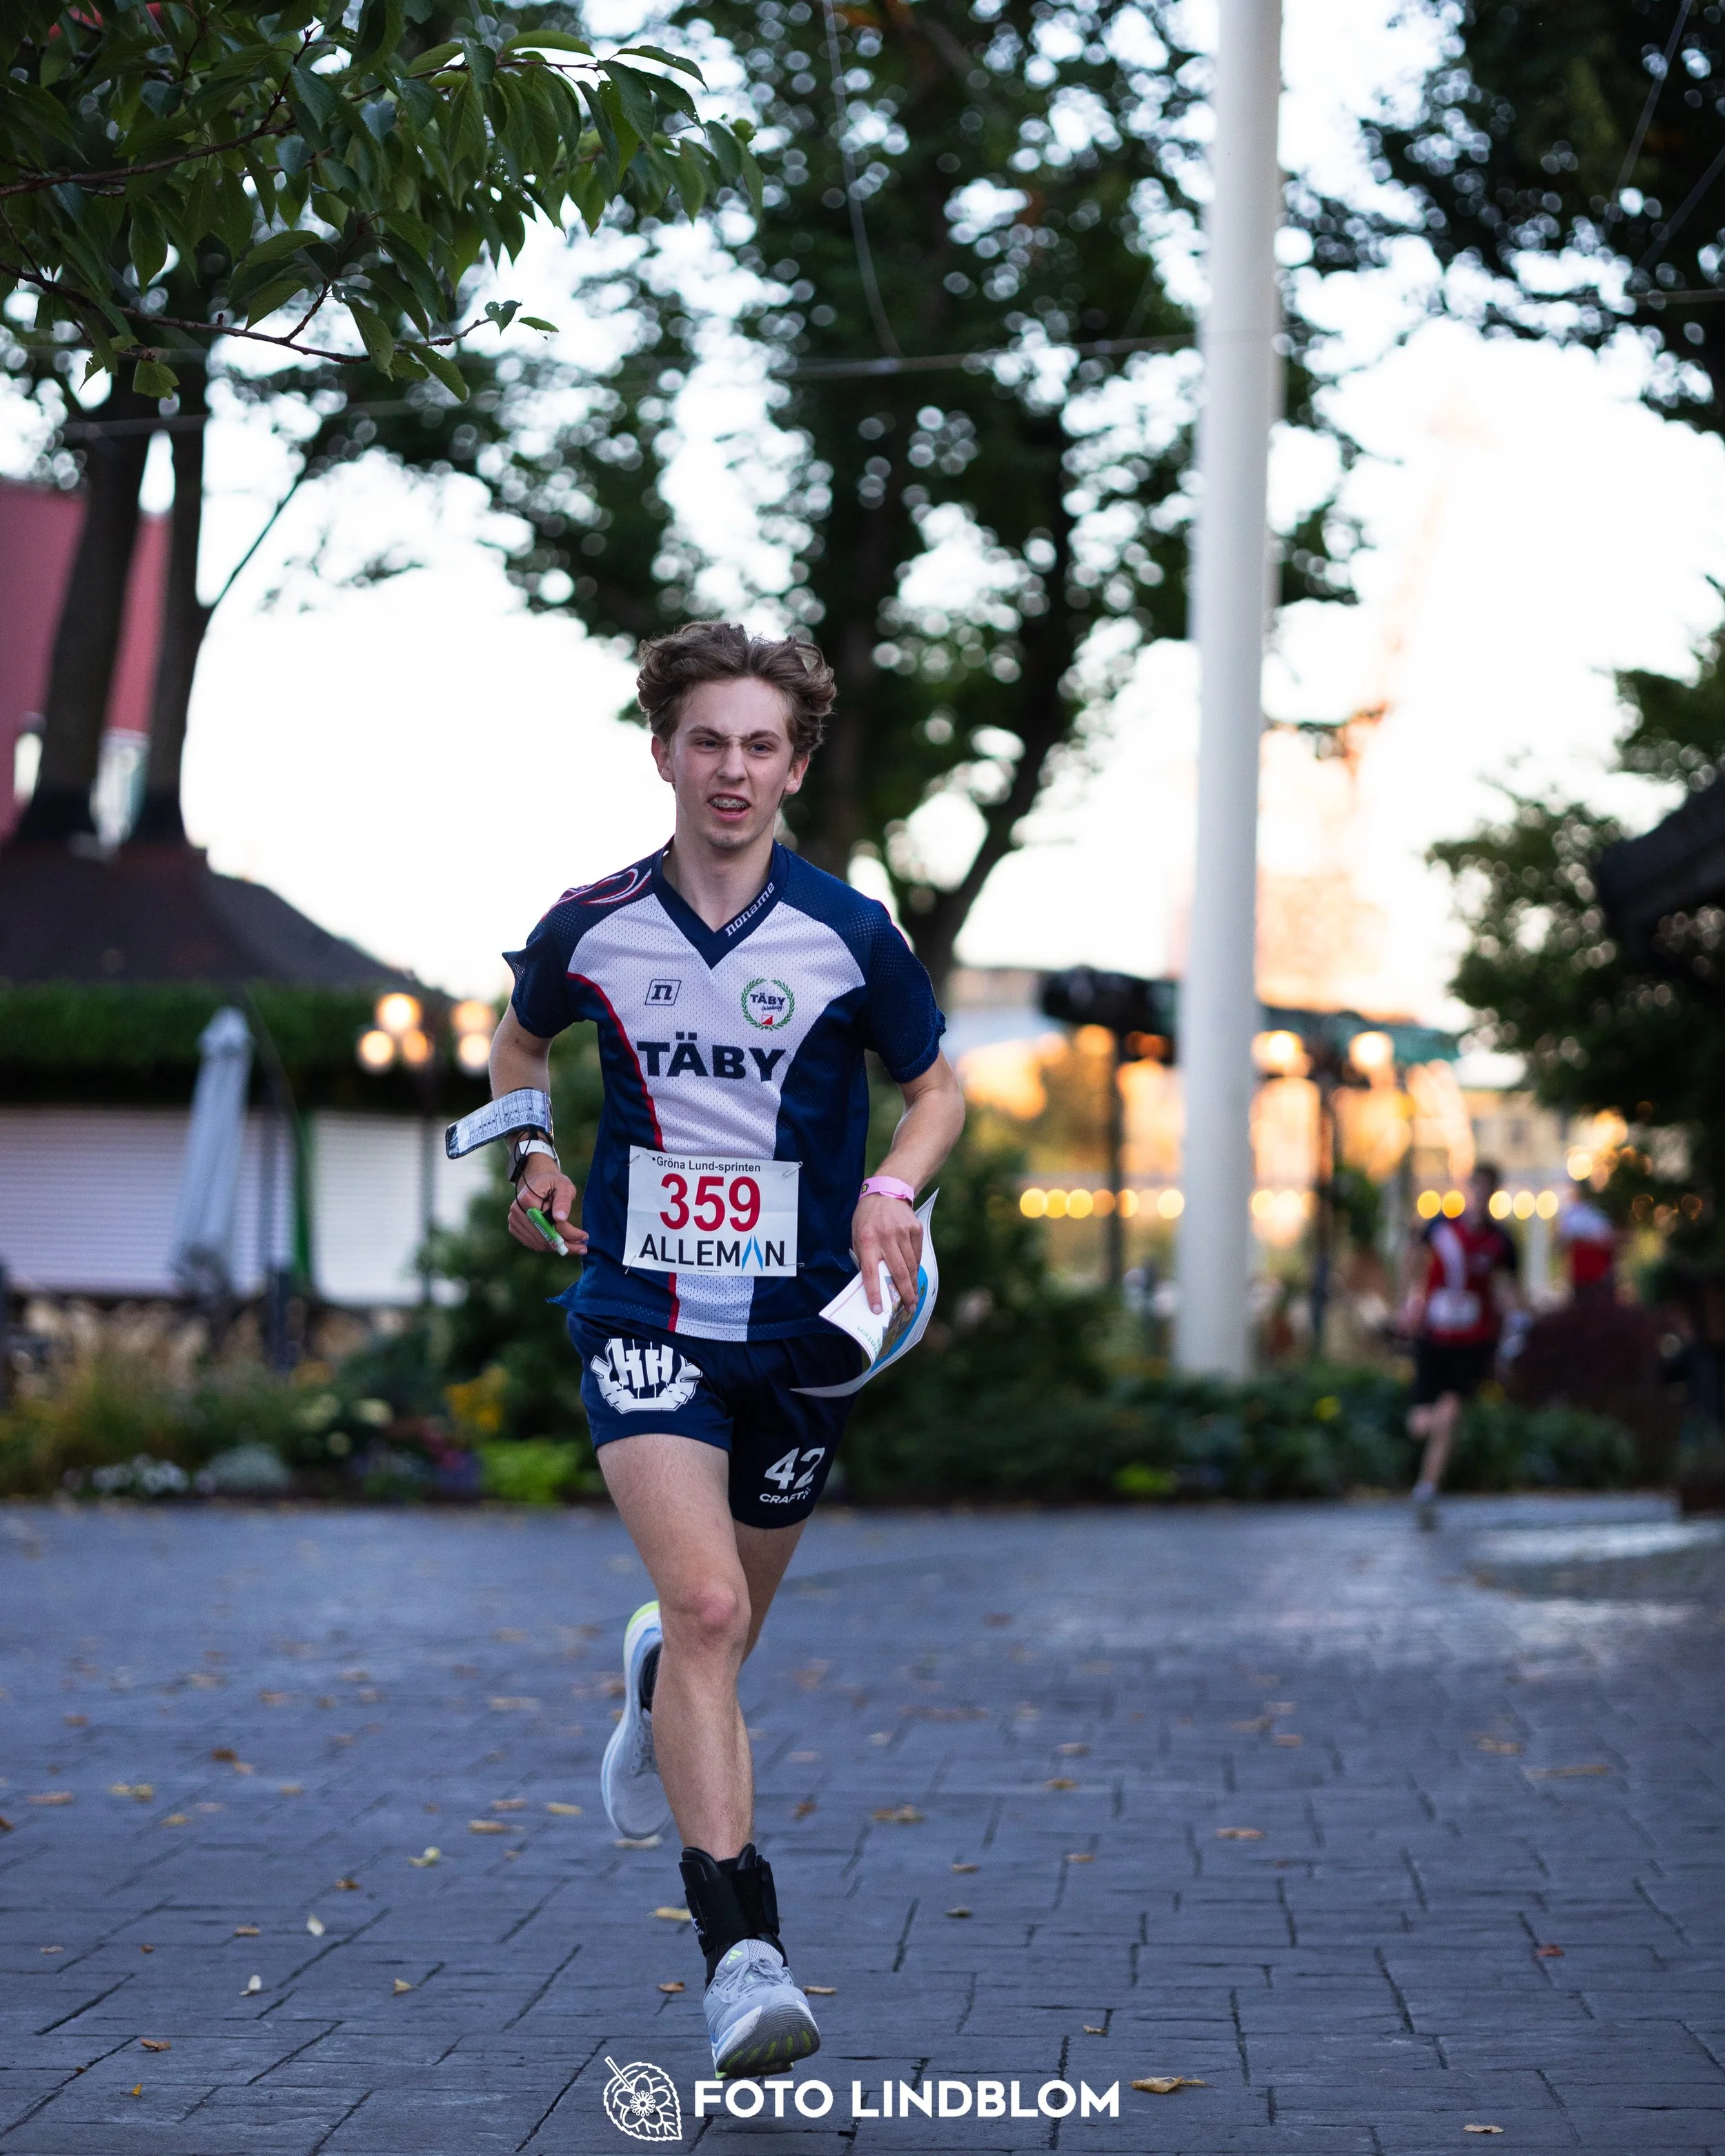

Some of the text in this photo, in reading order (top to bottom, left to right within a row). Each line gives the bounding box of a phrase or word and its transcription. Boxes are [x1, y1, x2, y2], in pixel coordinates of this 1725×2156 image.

[725, 882, 774, 936] noname
[750, 993, 786, 1005] TÄBY
[636, 1031, 786, 1082] TÄBY
[657, 1156, 761, 1173] Gröna Lund-sprinten
[660, 1173, 760, 1232] 359
[638, 1234, 785, 1272] ALLEMAN
[765, 1447, 825, 1489] 42
[760, 1491, 805, 1503] CRAFT
